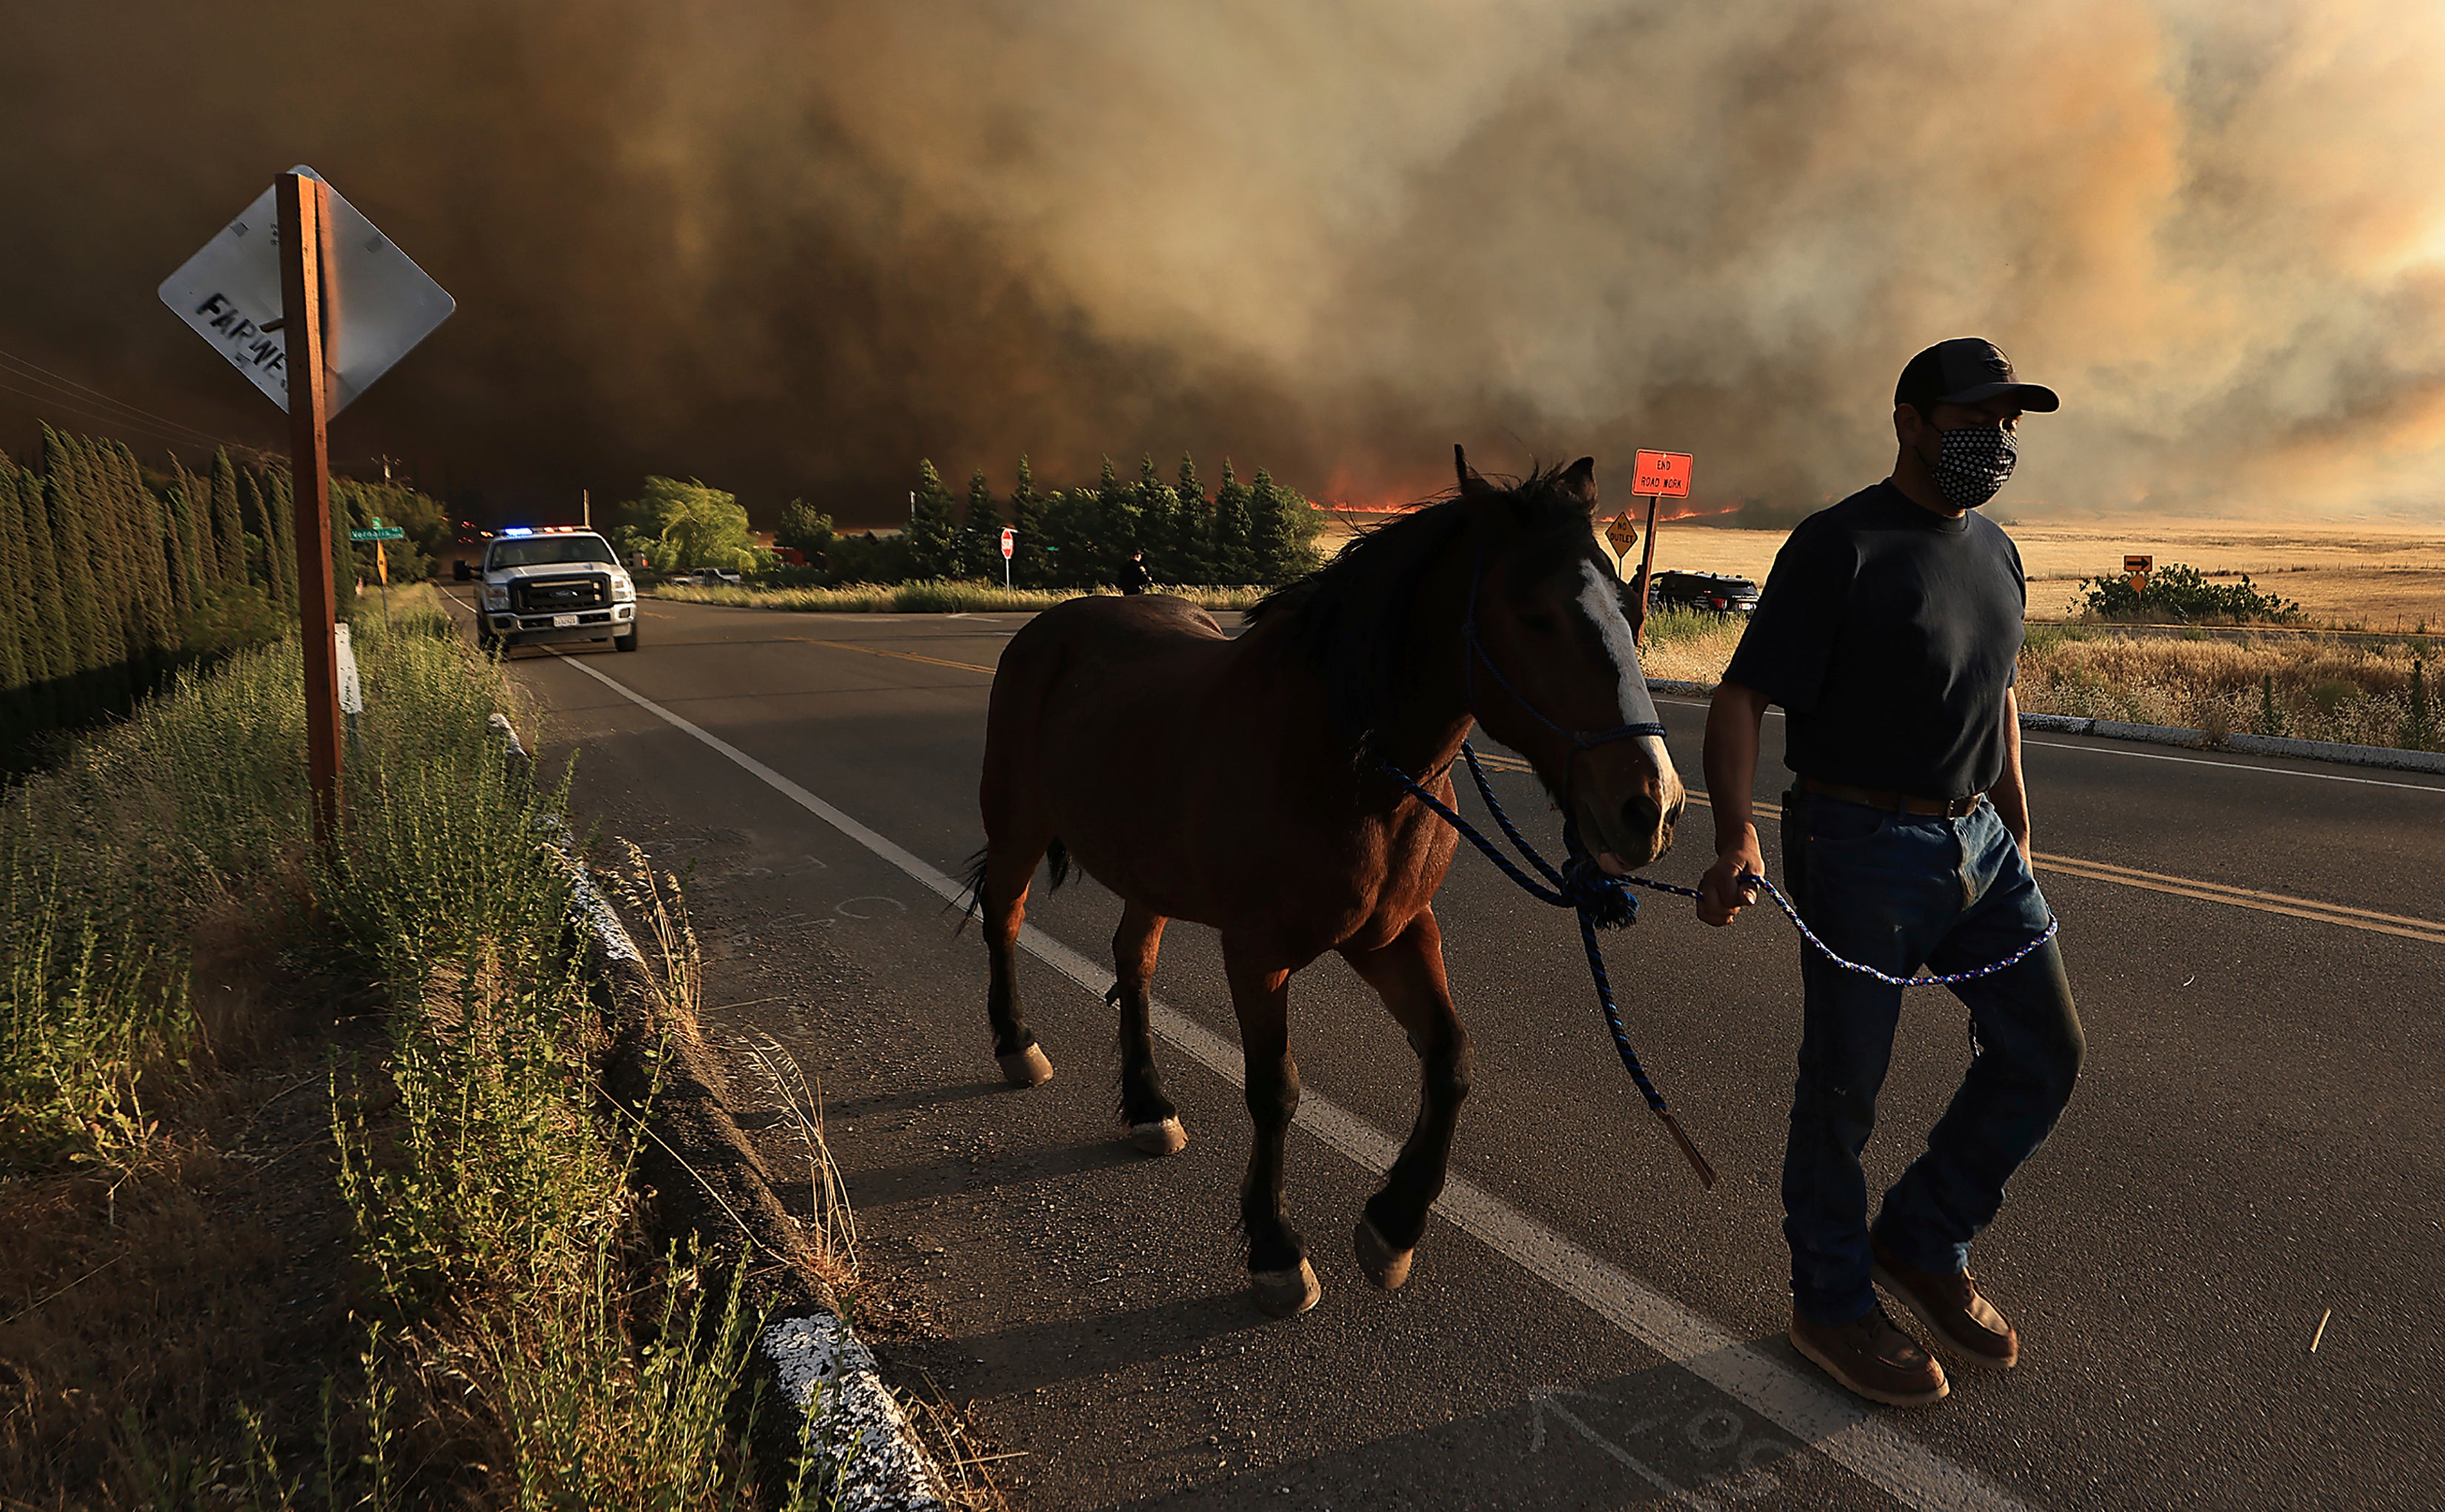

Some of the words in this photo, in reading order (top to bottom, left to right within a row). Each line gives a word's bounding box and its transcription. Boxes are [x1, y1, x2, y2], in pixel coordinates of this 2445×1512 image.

[1657, 460, 1671, 470] END
[1641, 476, 1660, 487] ROAD
[1663, 479, 1682, 489] WORK
[1617, 522, 1626, 530] NO
[1611, 532, 1633, 543] OUTLET
